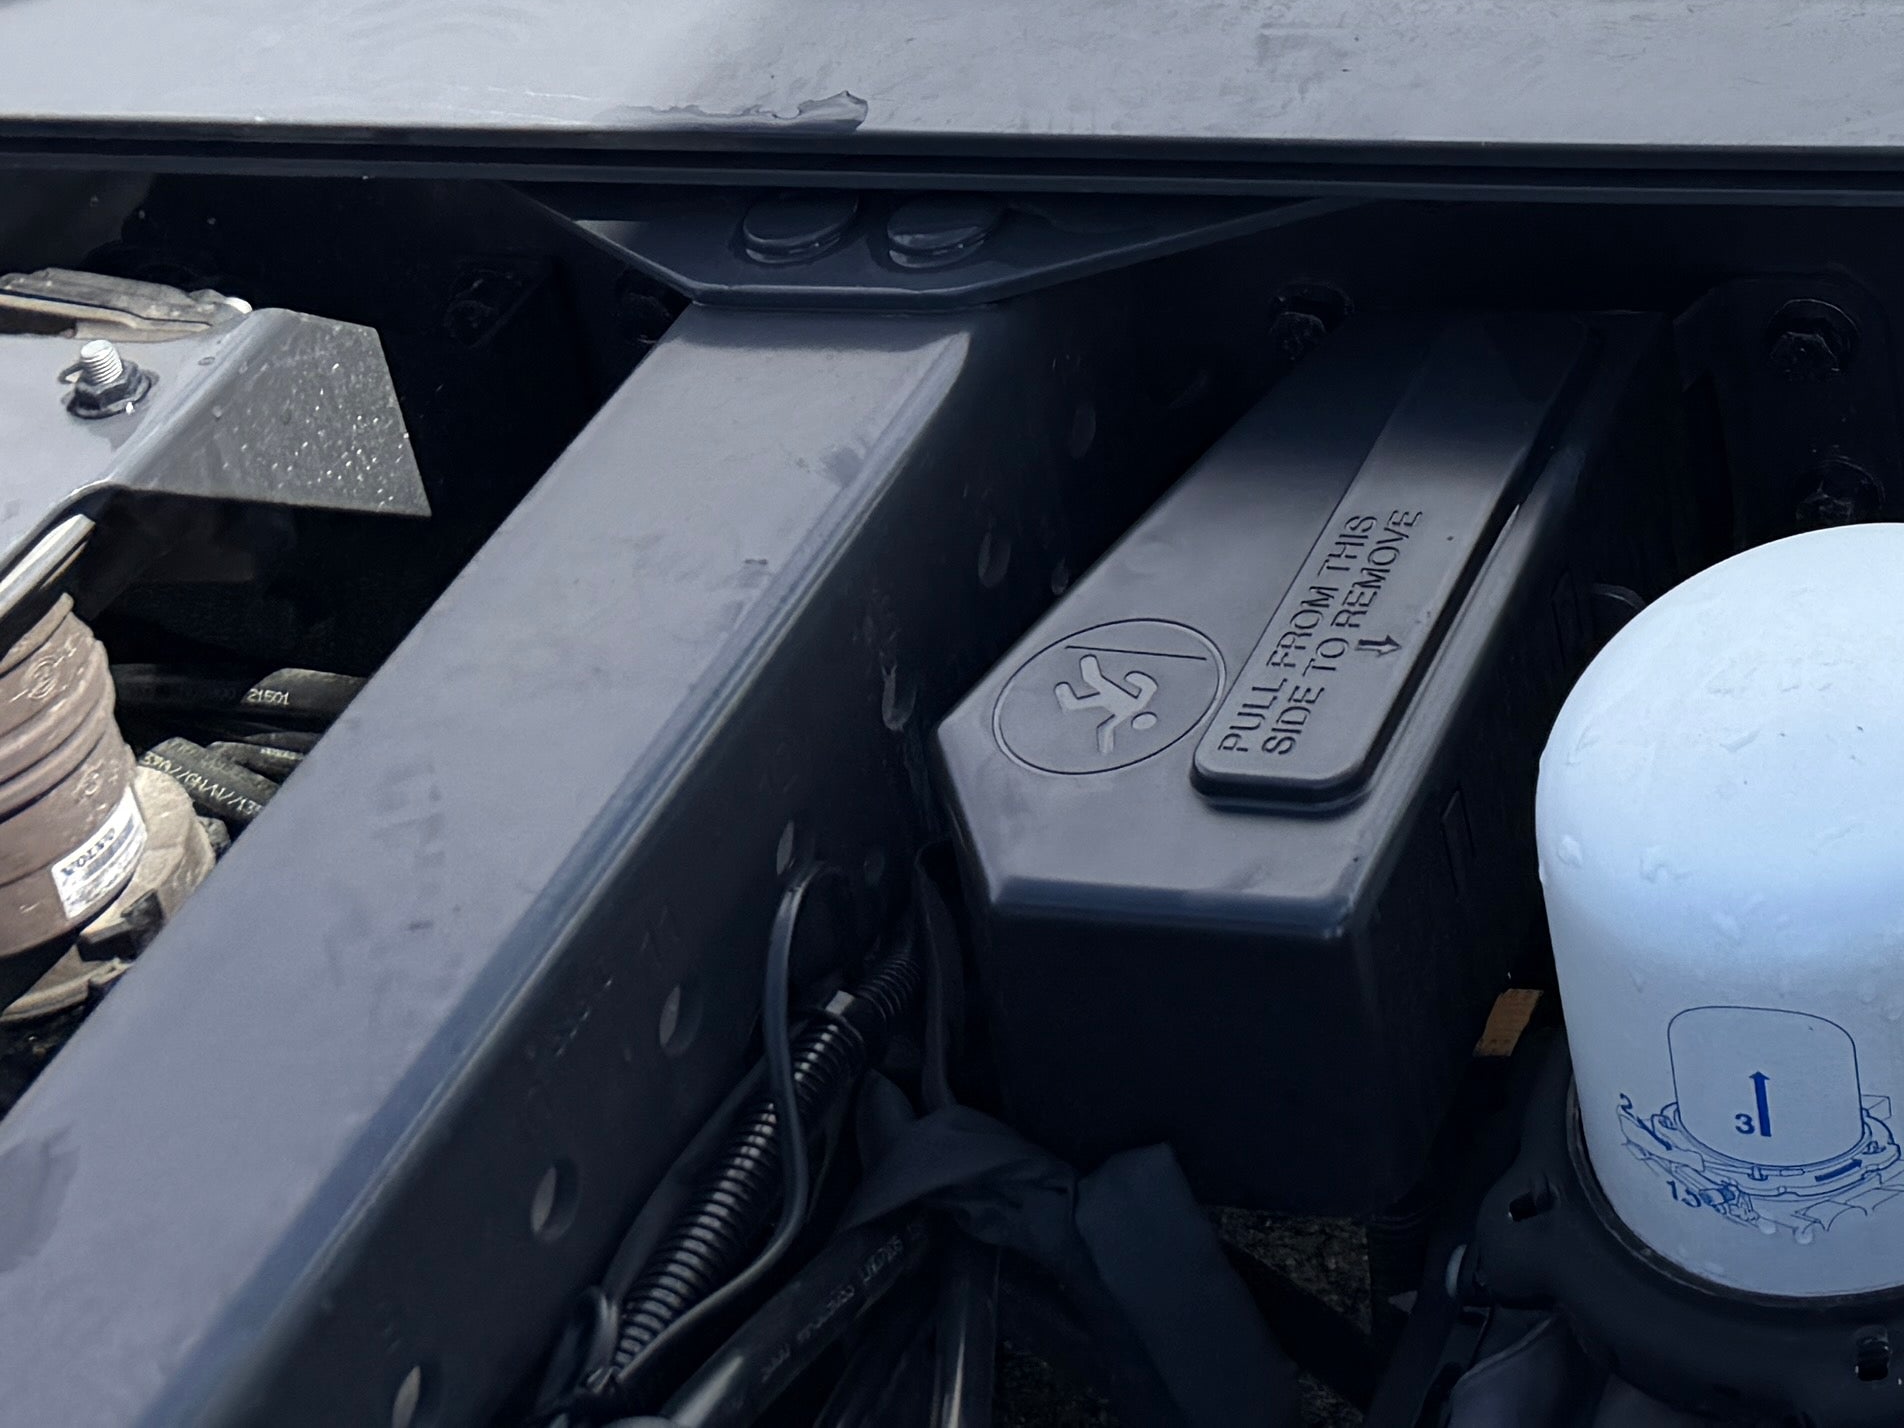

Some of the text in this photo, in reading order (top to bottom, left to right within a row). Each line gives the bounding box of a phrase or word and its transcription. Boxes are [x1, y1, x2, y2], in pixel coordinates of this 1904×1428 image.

[1217, 515, 1377, 752] PULL FROM THIS
[1262, 510, 1423, 755] SIDE TO REMOVE
[1735, 1113, 1756, 1135] 3
